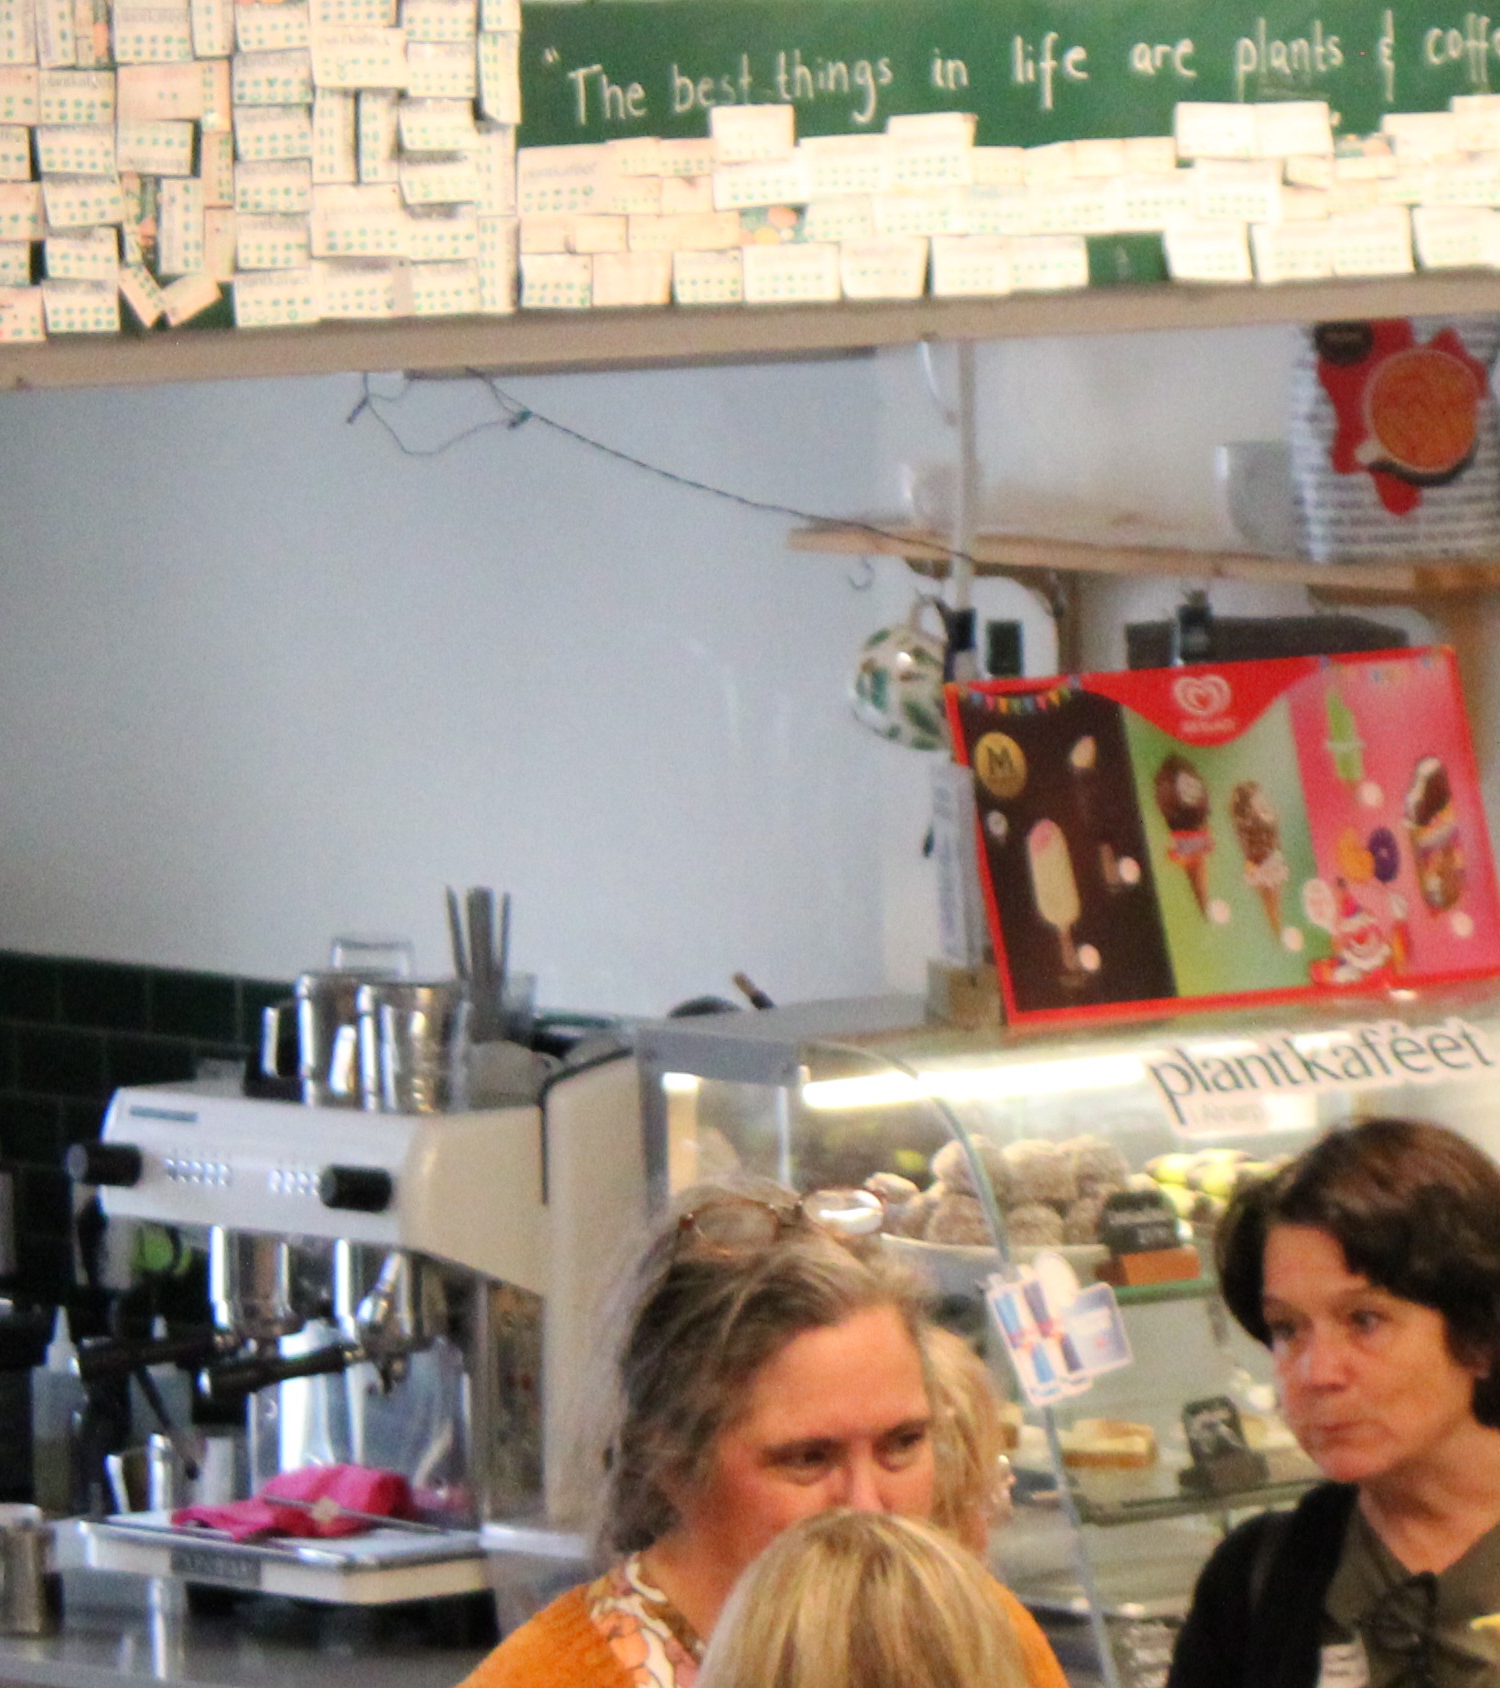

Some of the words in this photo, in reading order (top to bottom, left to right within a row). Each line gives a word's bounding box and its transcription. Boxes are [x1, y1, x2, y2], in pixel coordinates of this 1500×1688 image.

[670, 53, 754, 114] best
[777, 48, 894, 124] things
[931, 47, 970, 91] in
[1011, 31, 1090, 111] life
[1129, 38, 1198, 77] are
[1233, 16, 1345, 103] plants
[1152, 1020, 1494, 1126] plantkaféet
